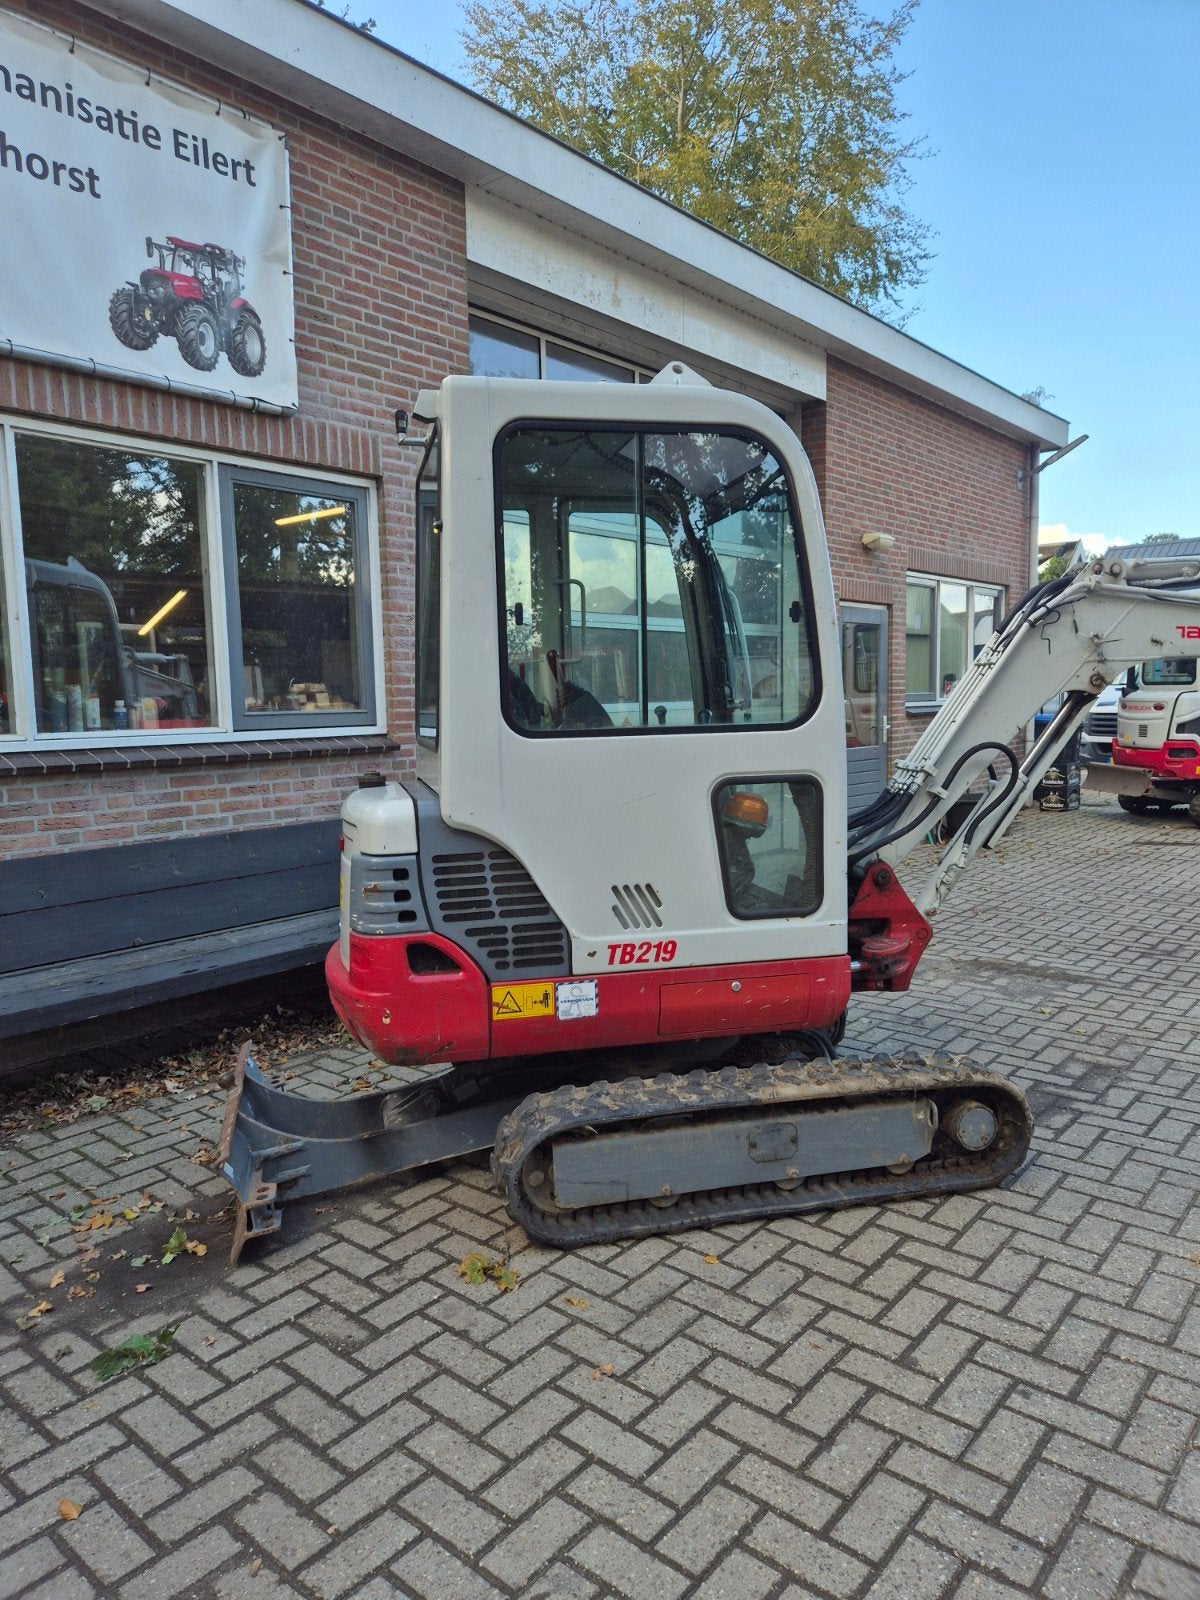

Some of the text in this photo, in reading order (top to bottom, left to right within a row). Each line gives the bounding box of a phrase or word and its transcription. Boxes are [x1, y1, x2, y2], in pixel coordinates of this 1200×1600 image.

[0, 131, 101, 199] horst
[172, 128, 257, 187] Eilert
[607, 940, 678, 966] TB219
